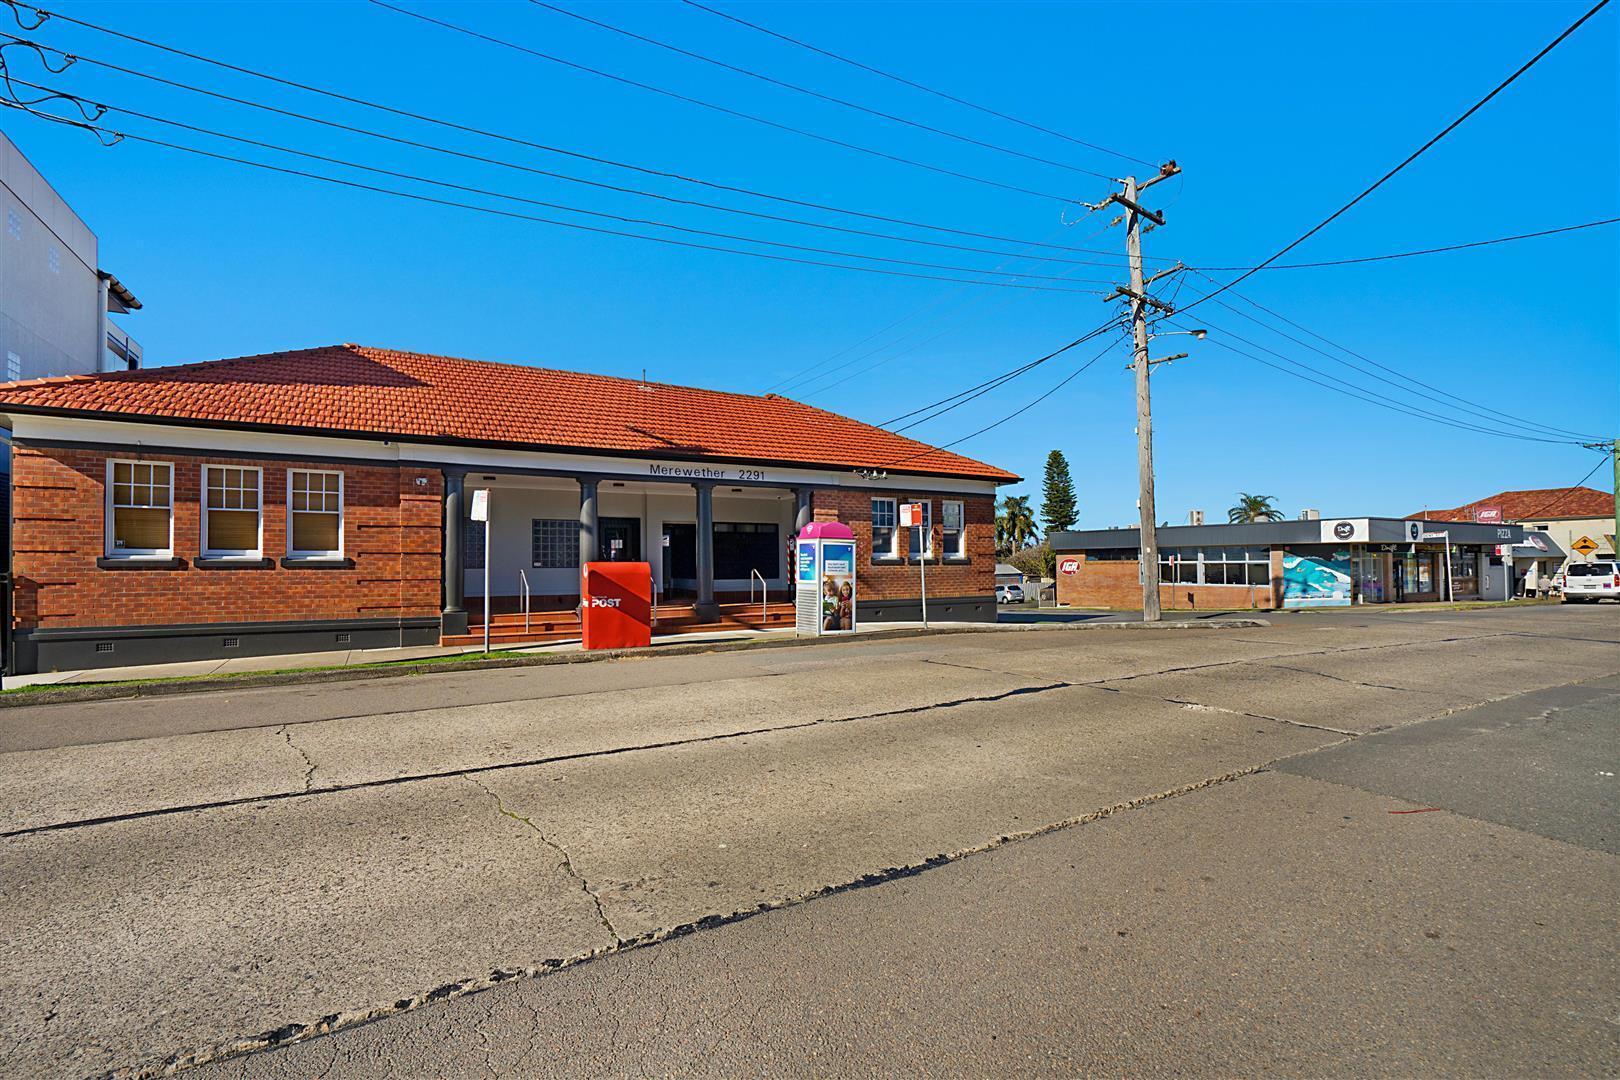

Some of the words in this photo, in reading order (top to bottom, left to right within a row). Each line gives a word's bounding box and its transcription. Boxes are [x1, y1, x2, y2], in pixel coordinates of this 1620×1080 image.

[649, 464, 725, 478] Merewether
[738, 469, 765, 480] 2291
[1480, 510, 1497, 518] IGA
[1497, 528, 1511, 538] PIZZA
[1062, 561, 1078, 571] IGA
[591, 598, 621, 608] POST
